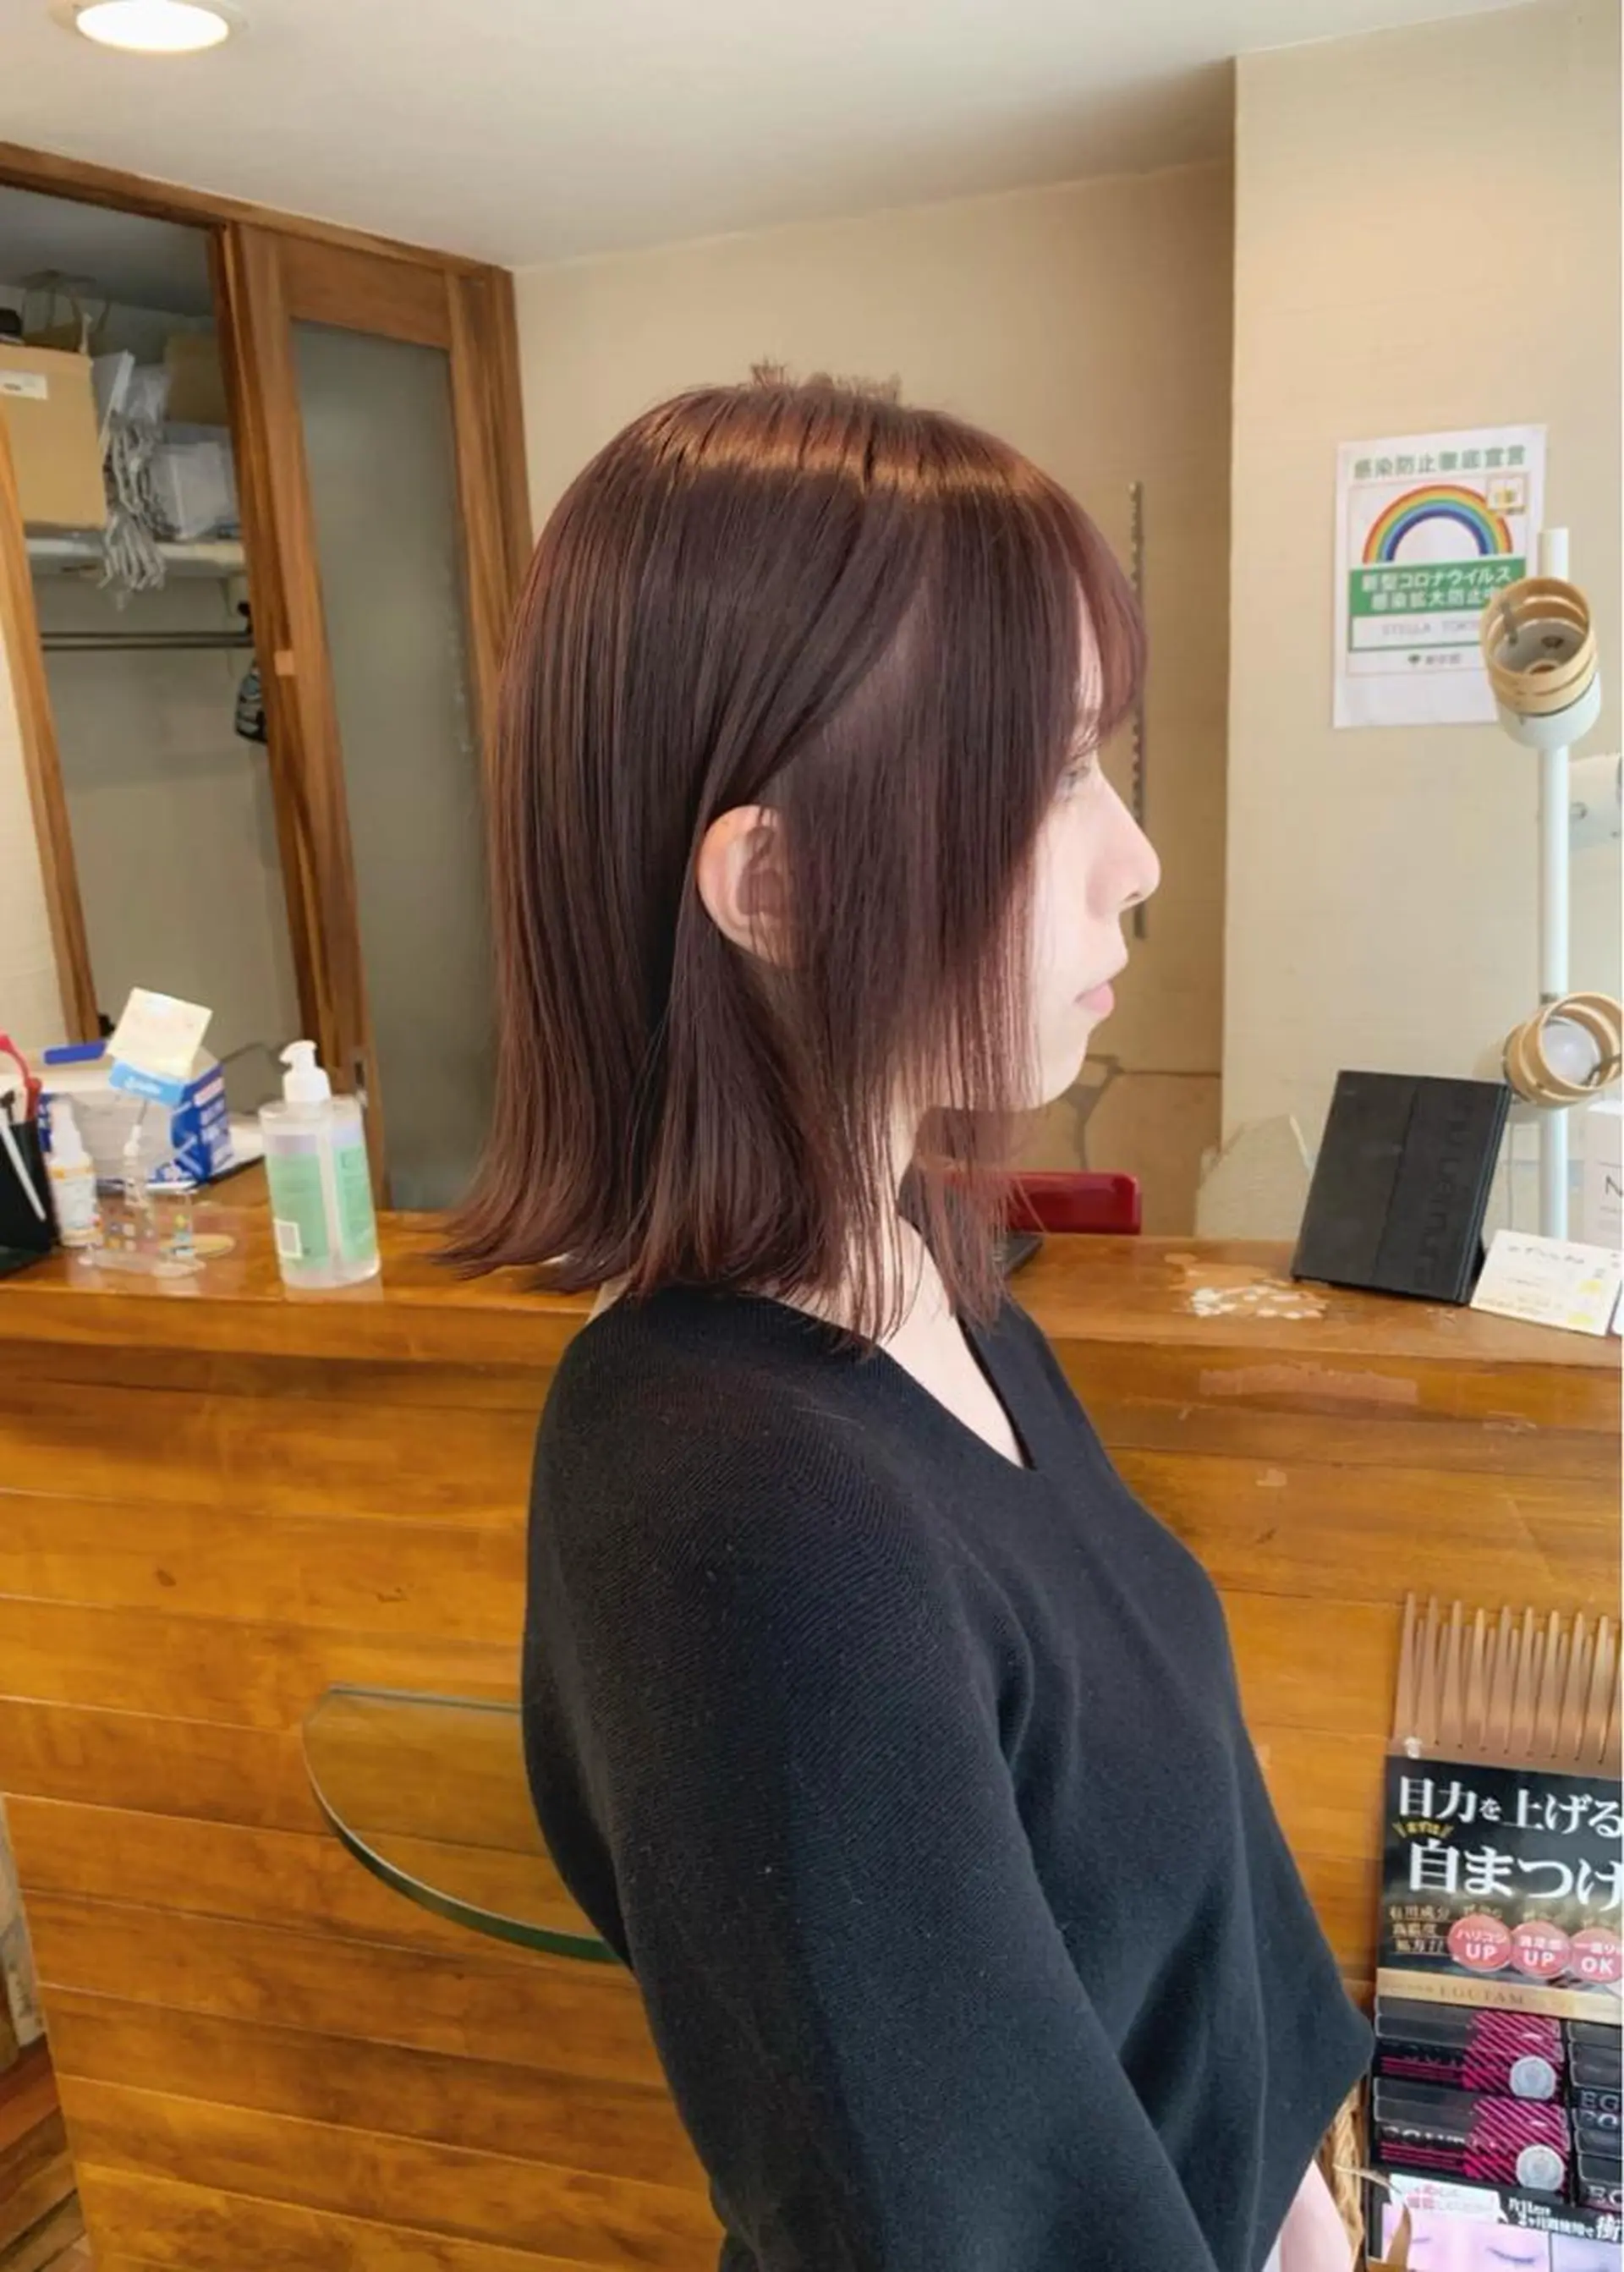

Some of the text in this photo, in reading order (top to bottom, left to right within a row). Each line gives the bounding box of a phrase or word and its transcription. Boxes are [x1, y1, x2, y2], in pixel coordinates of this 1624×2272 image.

[1466, 1943, 1498, 1961] UP
[1523, 1948, 1555, 1967] UP
[1581, 1955, 1615, 1976] OK
